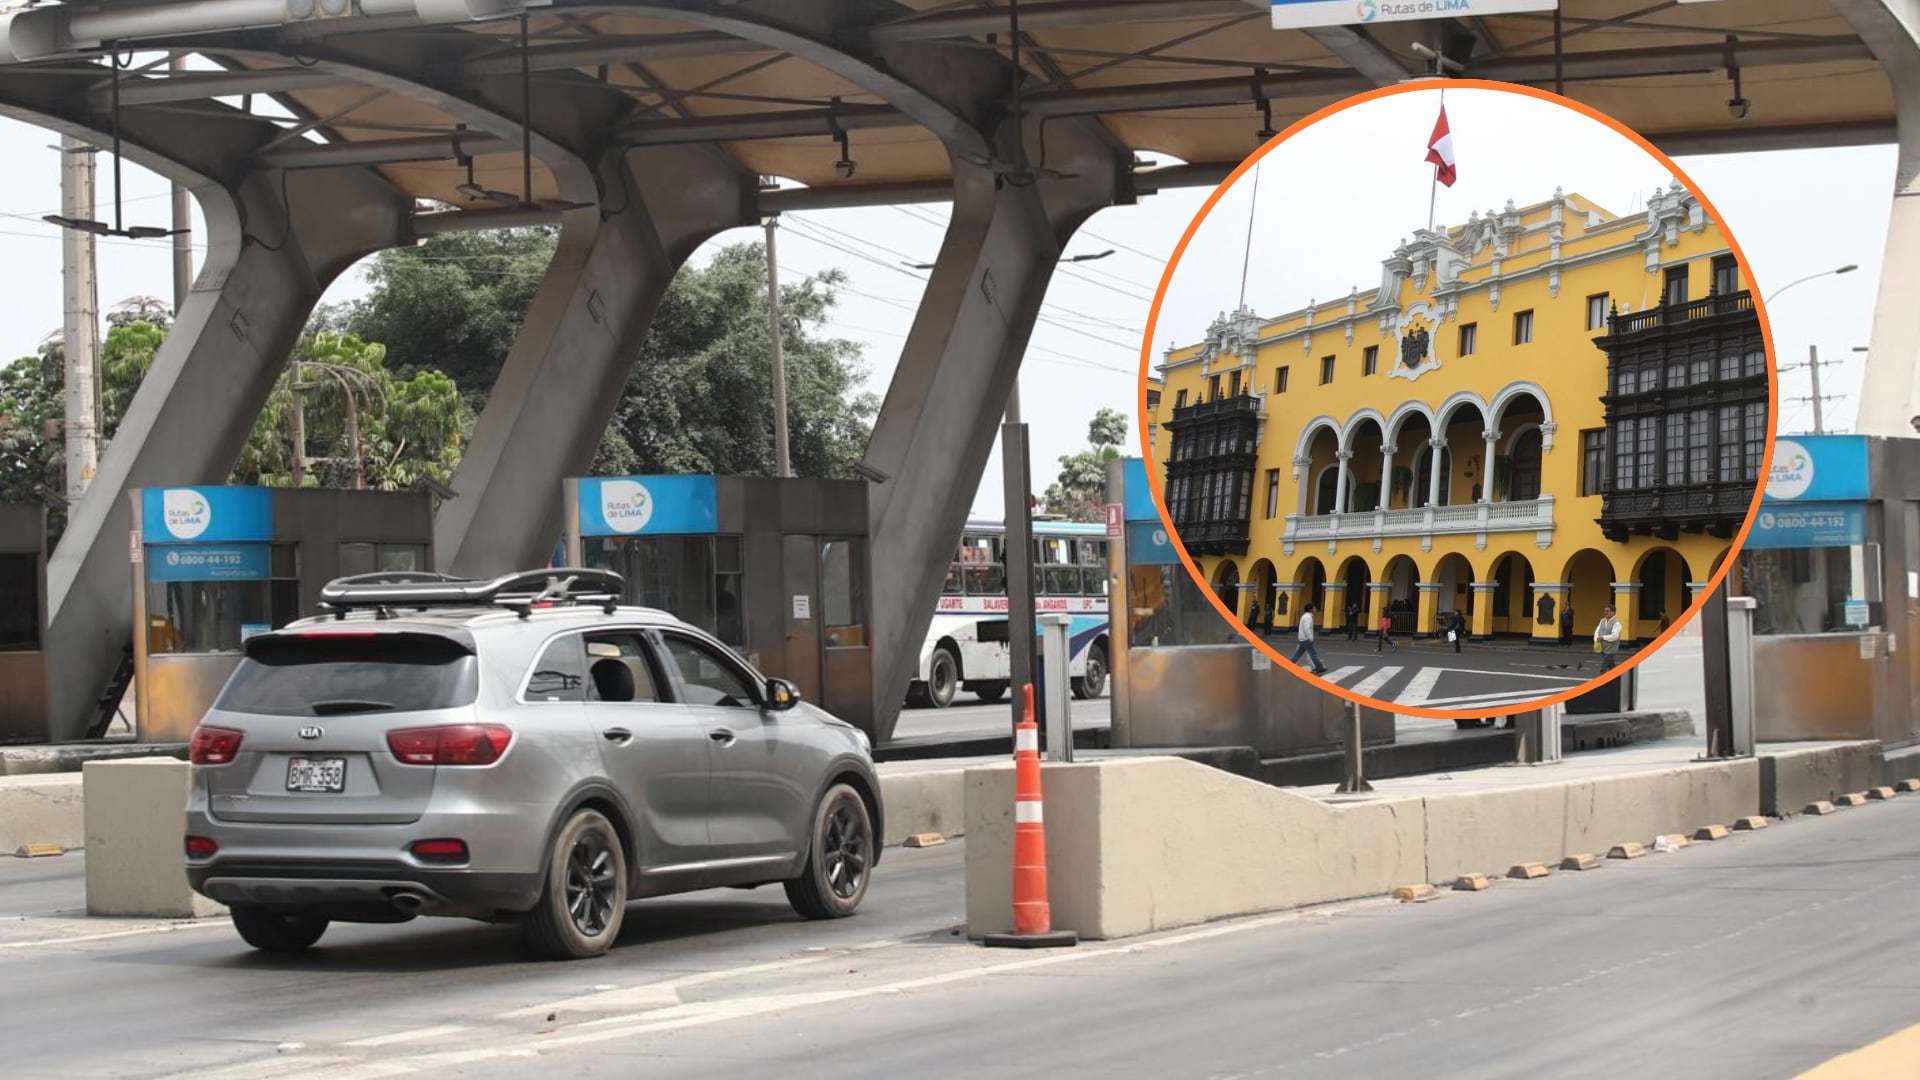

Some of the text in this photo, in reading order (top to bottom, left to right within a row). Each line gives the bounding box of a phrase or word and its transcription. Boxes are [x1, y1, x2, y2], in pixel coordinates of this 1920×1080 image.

[1381, 0, 1470, 15] Rutas de LIMA
[1775, 472, 1803, 482] LIMA
[607, 501, 631, 510] Rutas
[619, 509, 642, 518] LIMA
[180, 517, 201, 525] LIMA
[1777, 517, 1845, 529] 0800-44-192
[180, 555, 241, 565] 0800-44-192
[300, 727, 320, 738] KIA
[290, 766, 341, 786] BMR-358
